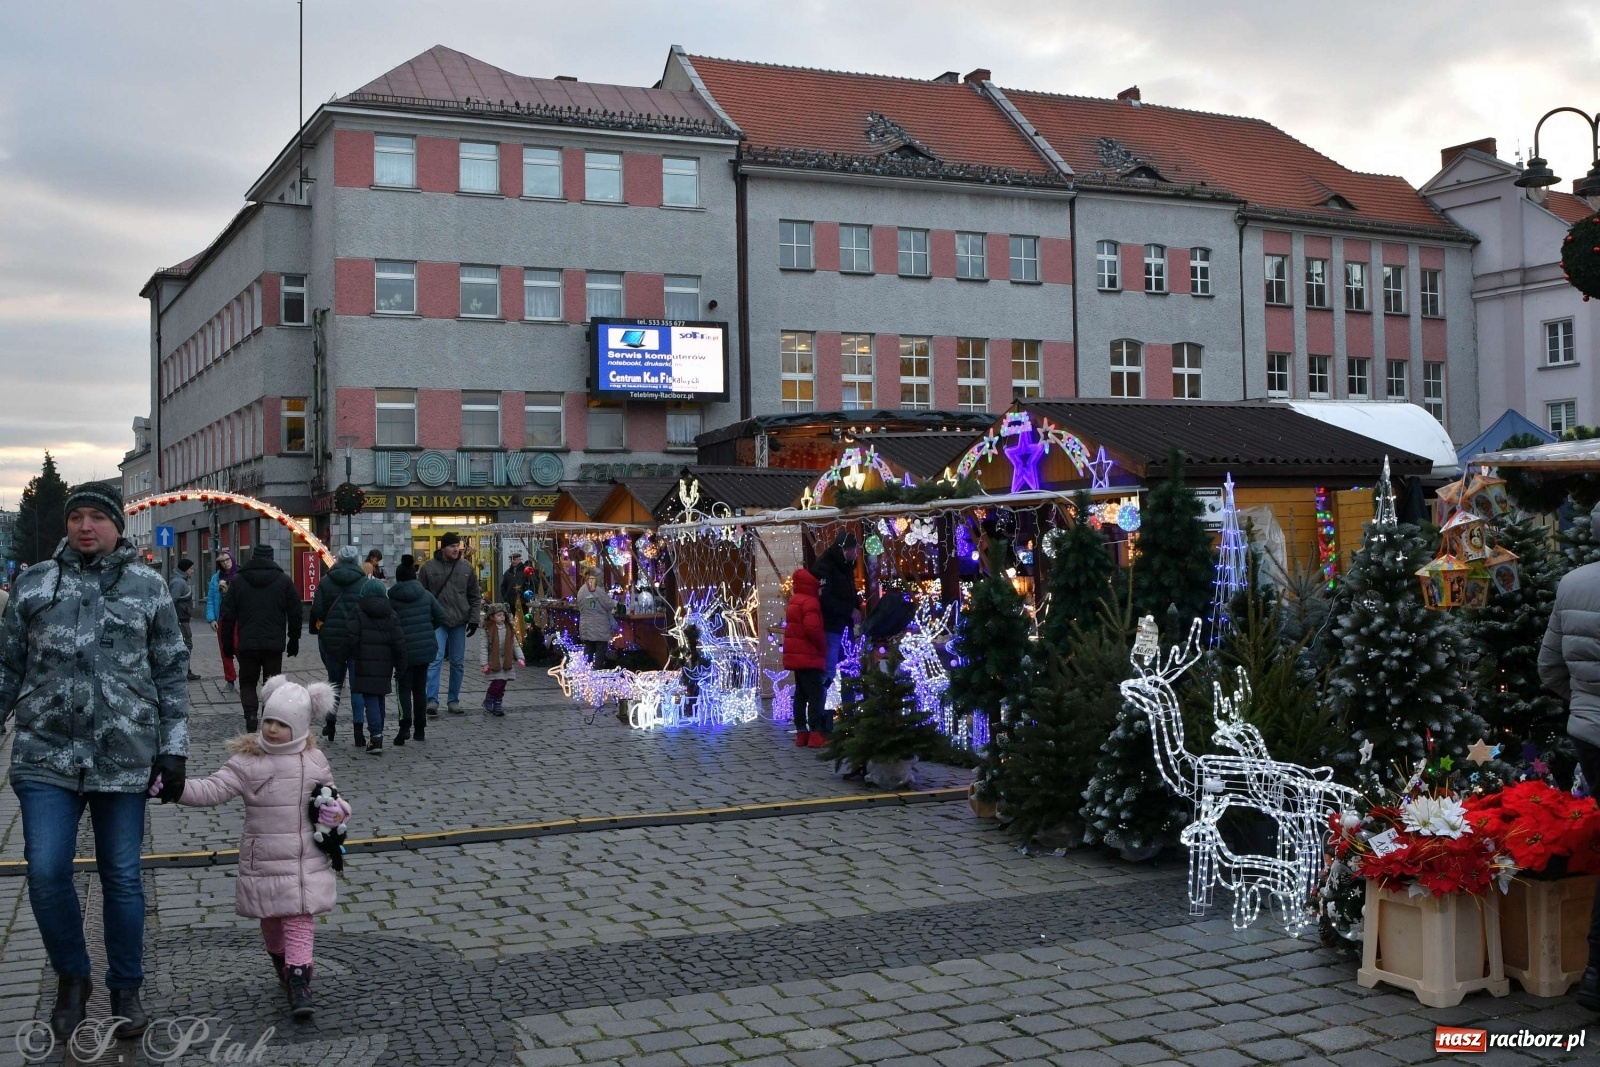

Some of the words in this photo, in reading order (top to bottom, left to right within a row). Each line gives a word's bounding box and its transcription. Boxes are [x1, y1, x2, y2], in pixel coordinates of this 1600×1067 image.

[607, 351, 642, 359] Serwis
[645, 352, 706, 361] komputerów
[609, 370, 641, 383] Centrum
[643, 371, 659, 384] Kas
[375, 451, 564, 487] BOLKO
[395, 495, 513, 508] DELIKATESY
